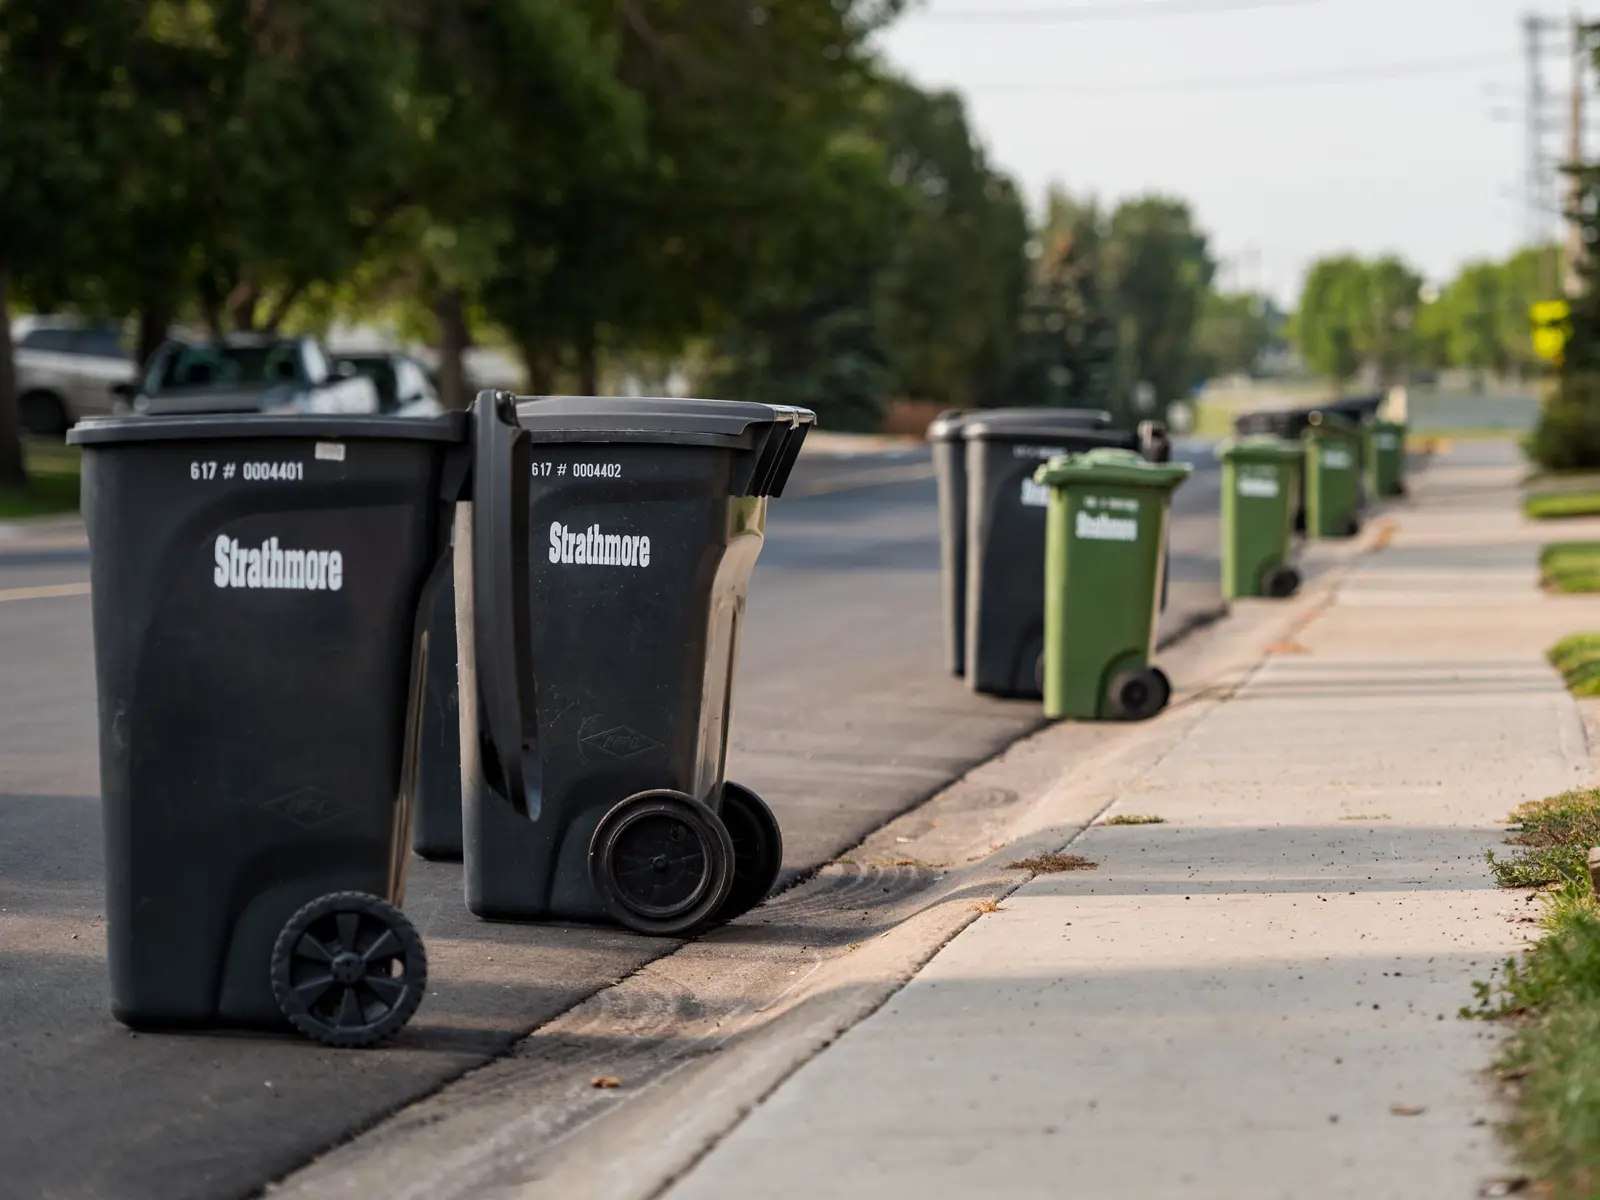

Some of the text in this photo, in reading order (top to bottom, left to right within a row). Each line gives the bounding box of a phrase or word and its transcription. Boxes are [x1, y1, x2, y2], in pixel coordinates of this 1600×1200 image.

[190, 462, 304, 481] 617 # 0004401
[531, 462, 622, 478] 617 # 0004402
[548, 521, 651, 568] Strathmore
[213, 534, 343, 591] Strathmore
